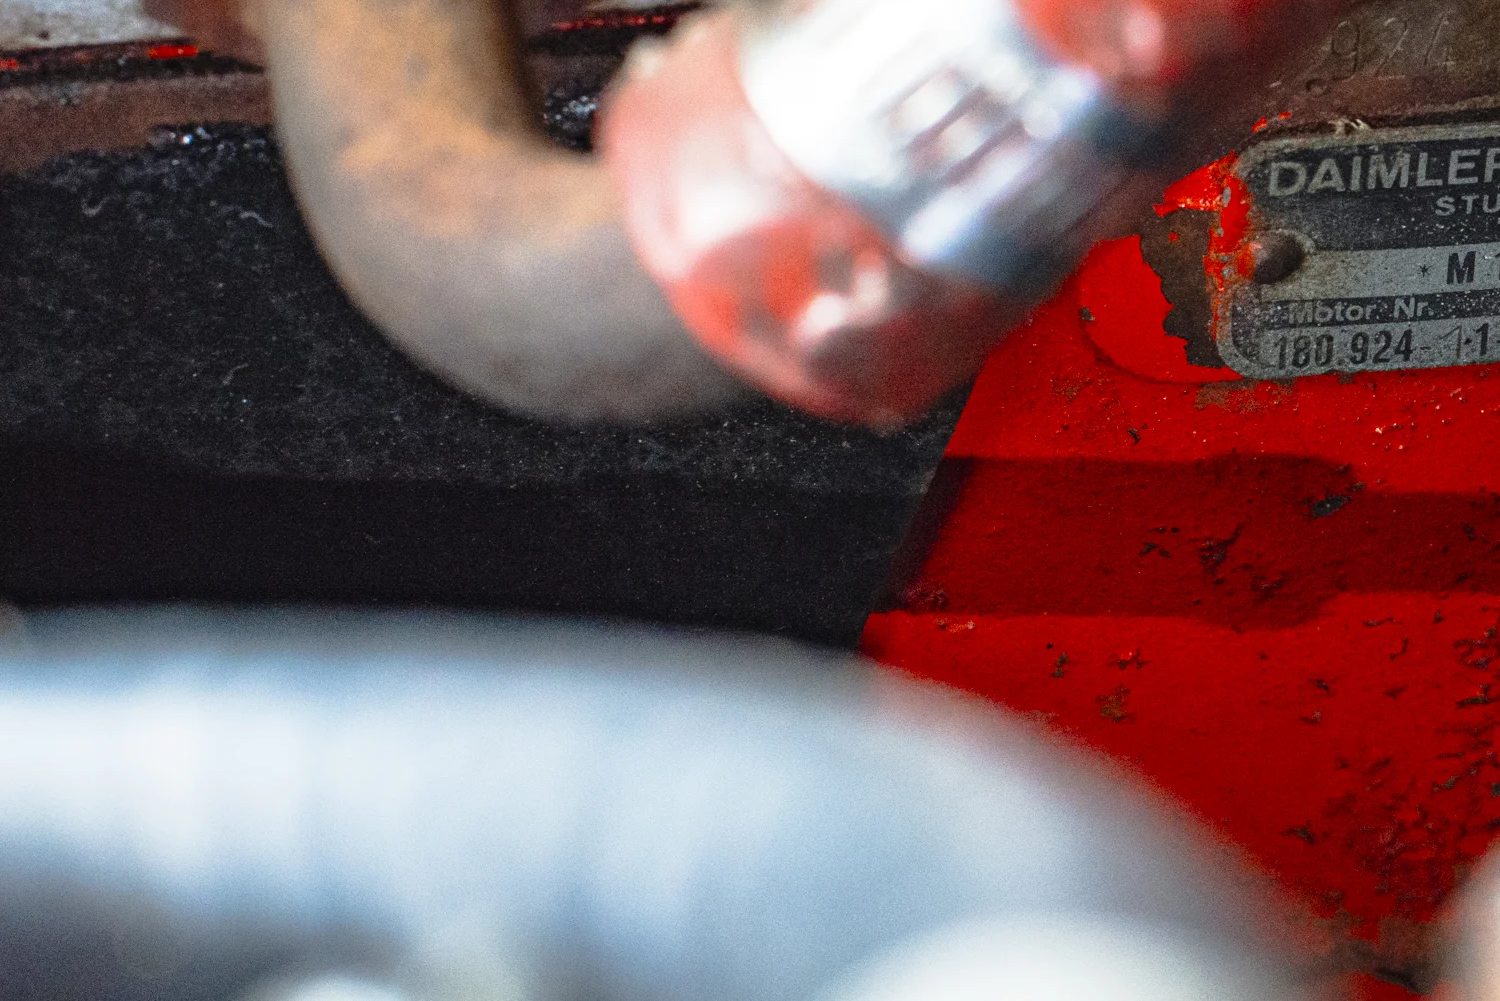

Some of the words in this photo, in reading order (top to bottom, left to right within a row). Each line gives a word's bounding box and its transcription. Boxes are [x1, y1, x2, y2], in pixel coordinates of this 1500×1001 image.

[1446, 251, 1476, 285] M
[1288, 300, 1377, 325] Motor
[1393, 296, 1435, 319] Nr.
